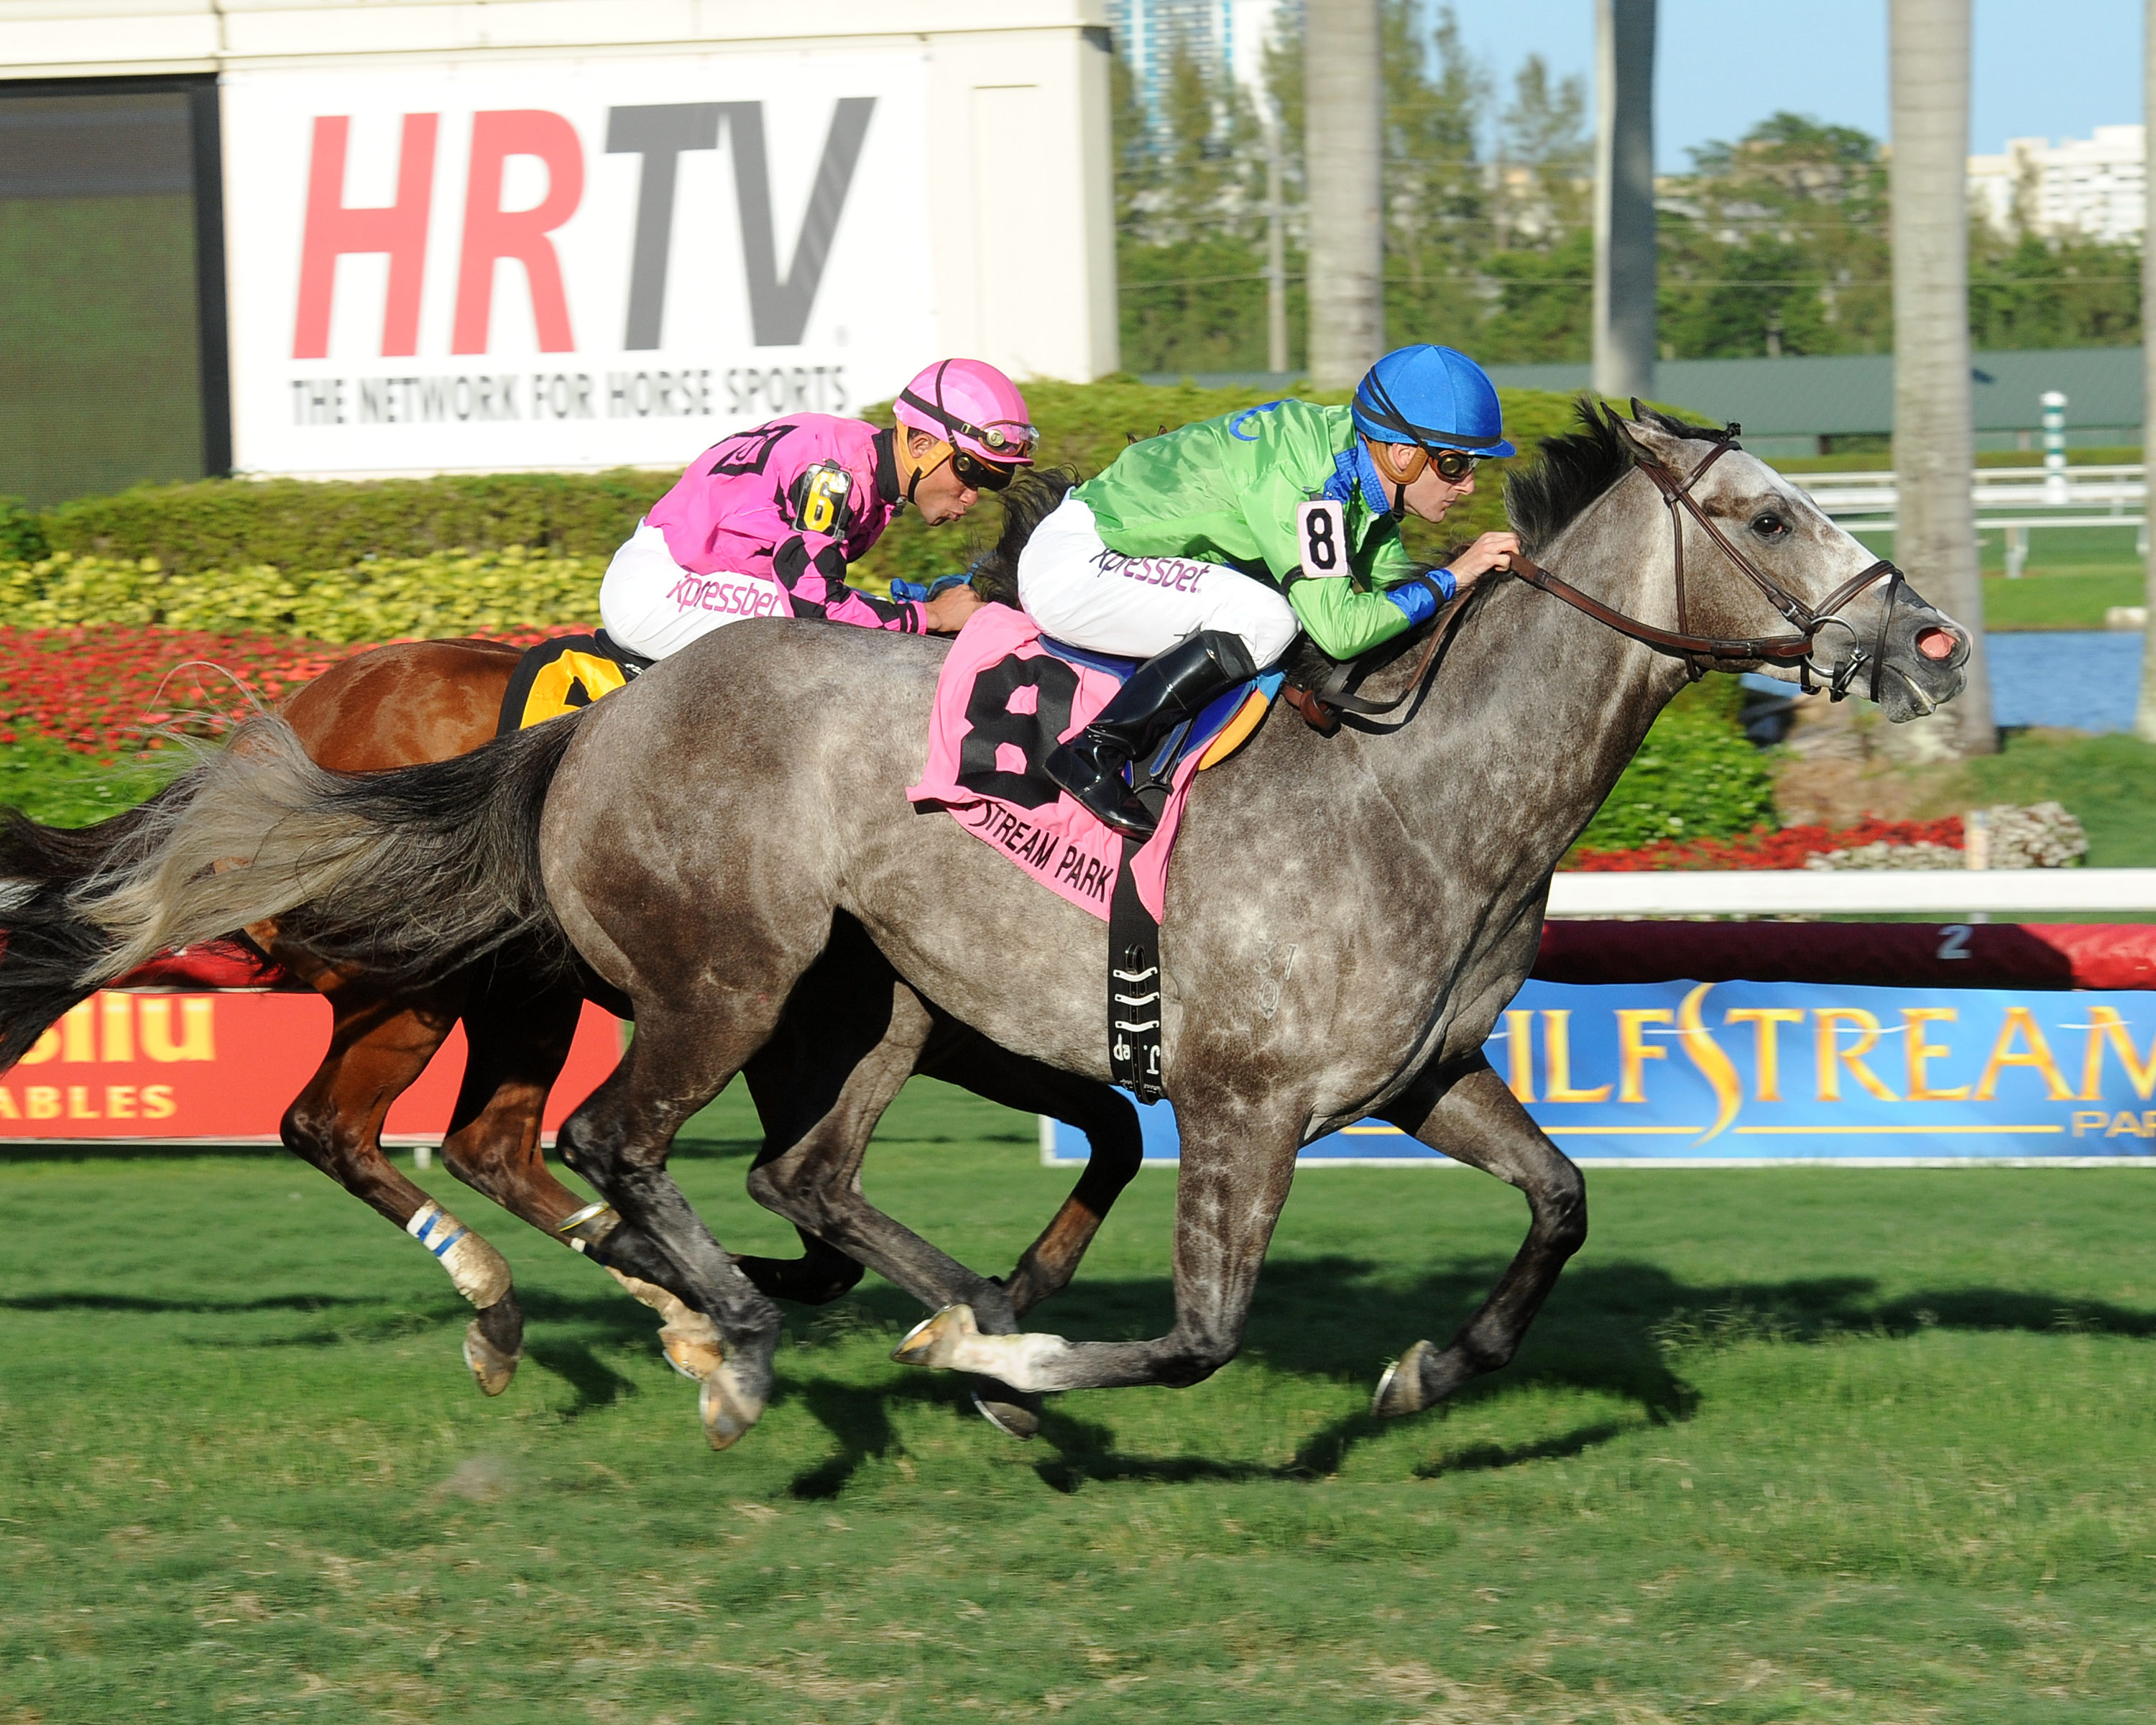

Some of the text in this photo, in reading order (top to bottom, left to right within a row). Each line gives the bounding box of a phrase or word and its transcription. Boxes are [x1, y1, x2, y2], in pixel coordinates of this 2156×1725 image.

[291, 96, 877, 359] HRTV
[290, 364, 847, 426] THE NETWORK FOR HORSE SPORTS
[803, 471, 834, 533] 6
[1306, 508, 1337, 570] 8
[954, 653, 1080, 811] 8
[1054, 845, 1114, 903] PARK
[1938, 924, 1973, 960] 2
